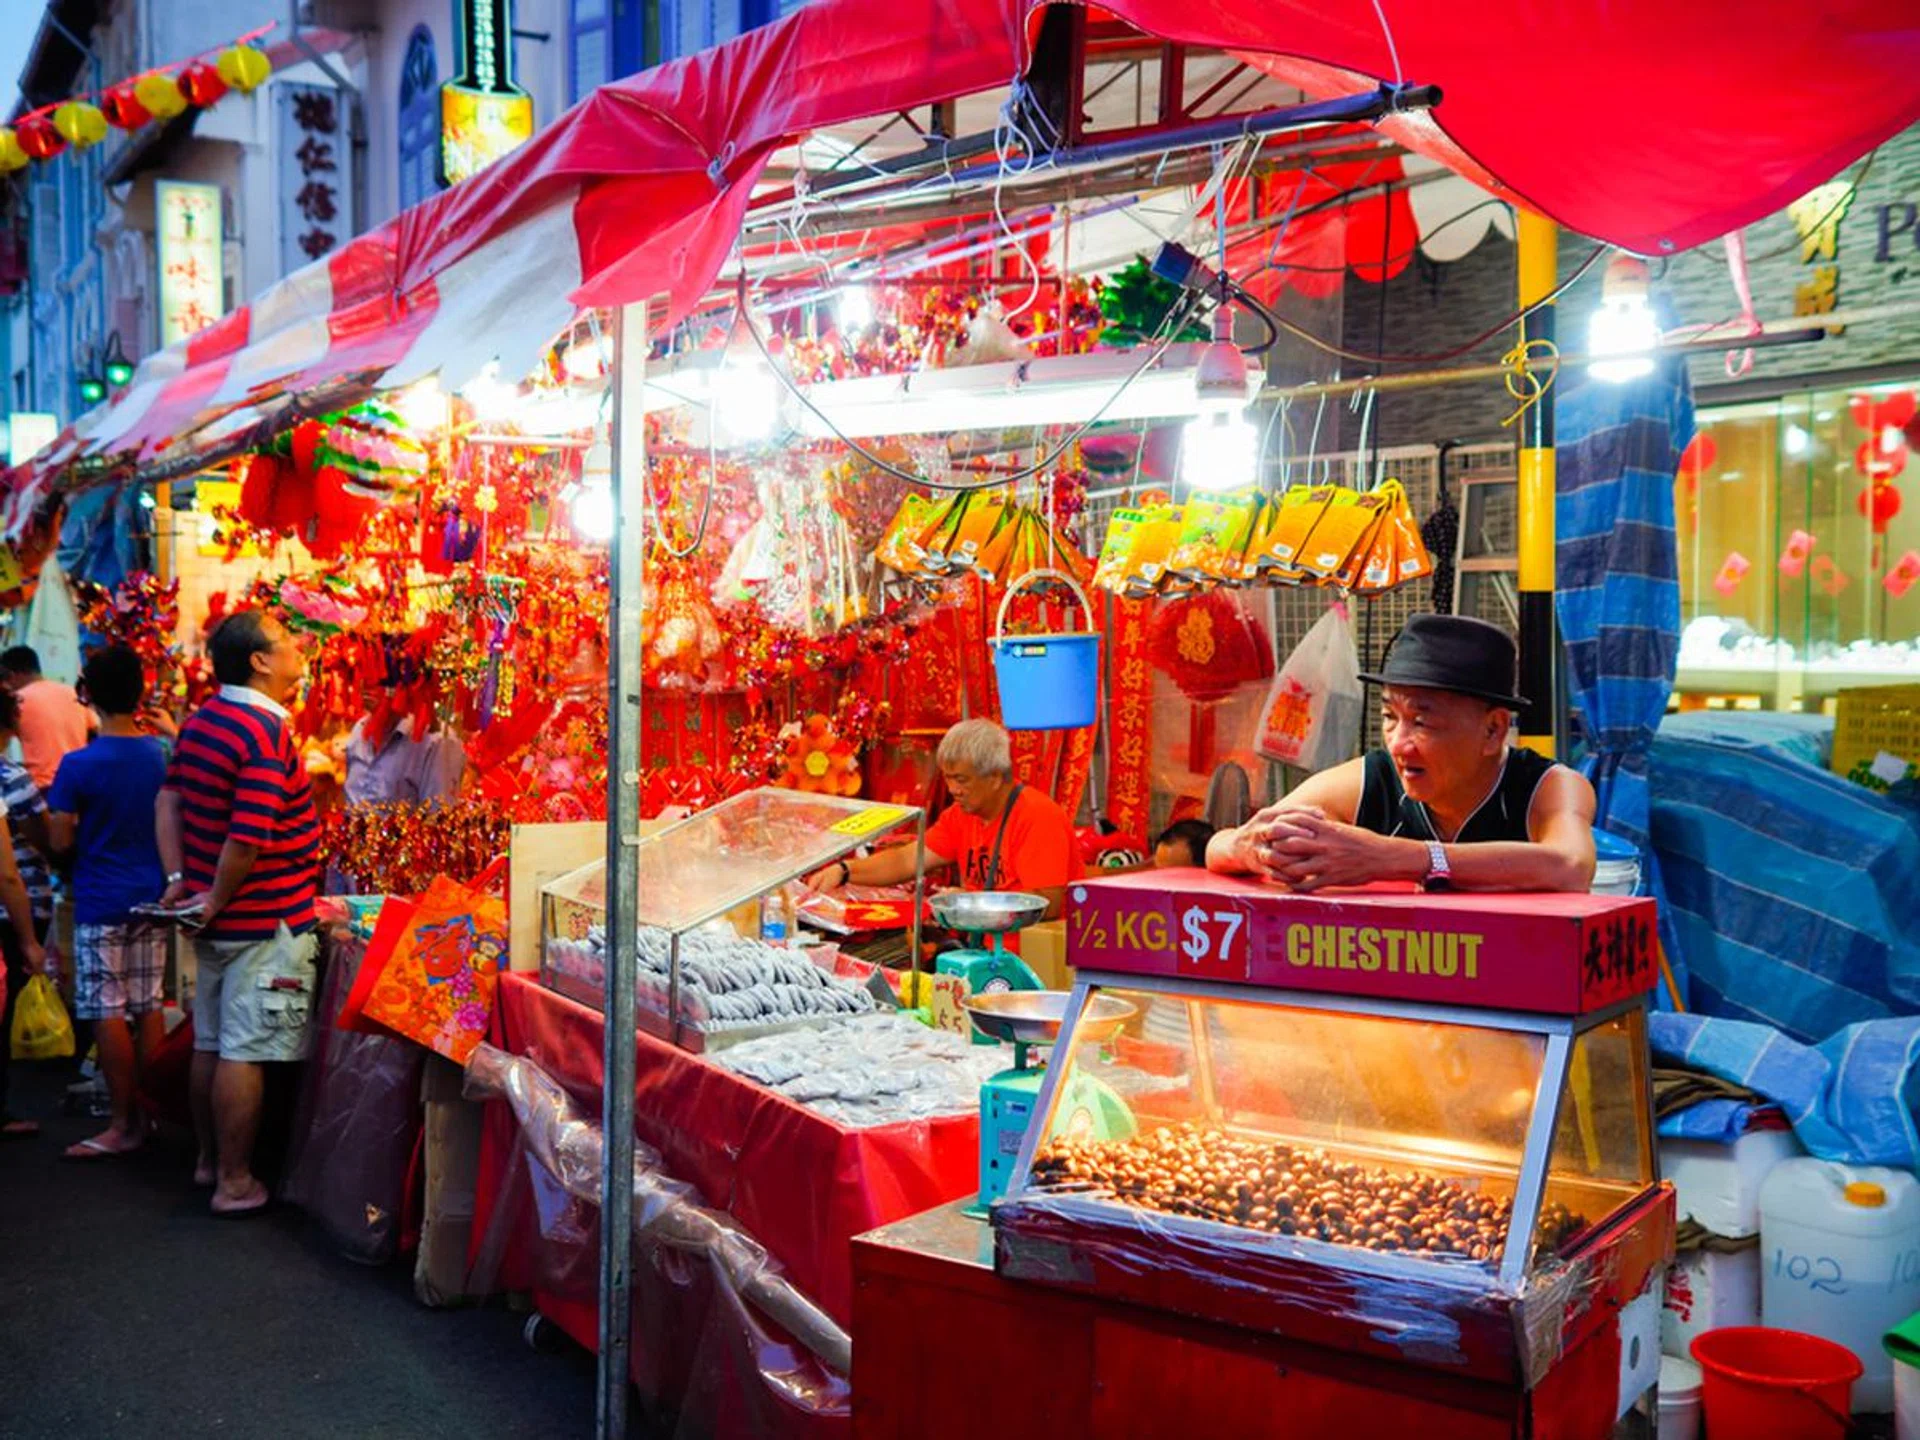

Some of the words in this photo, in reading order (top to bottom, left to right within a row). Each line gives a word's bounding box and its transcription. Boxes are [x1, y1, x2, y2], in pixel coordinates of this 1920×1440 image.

[1181, 905, 1244, 963] $7
[1287, 922, 1484, 978] CHESTNUT
[1774, 1249, 1848, 1294] 102
